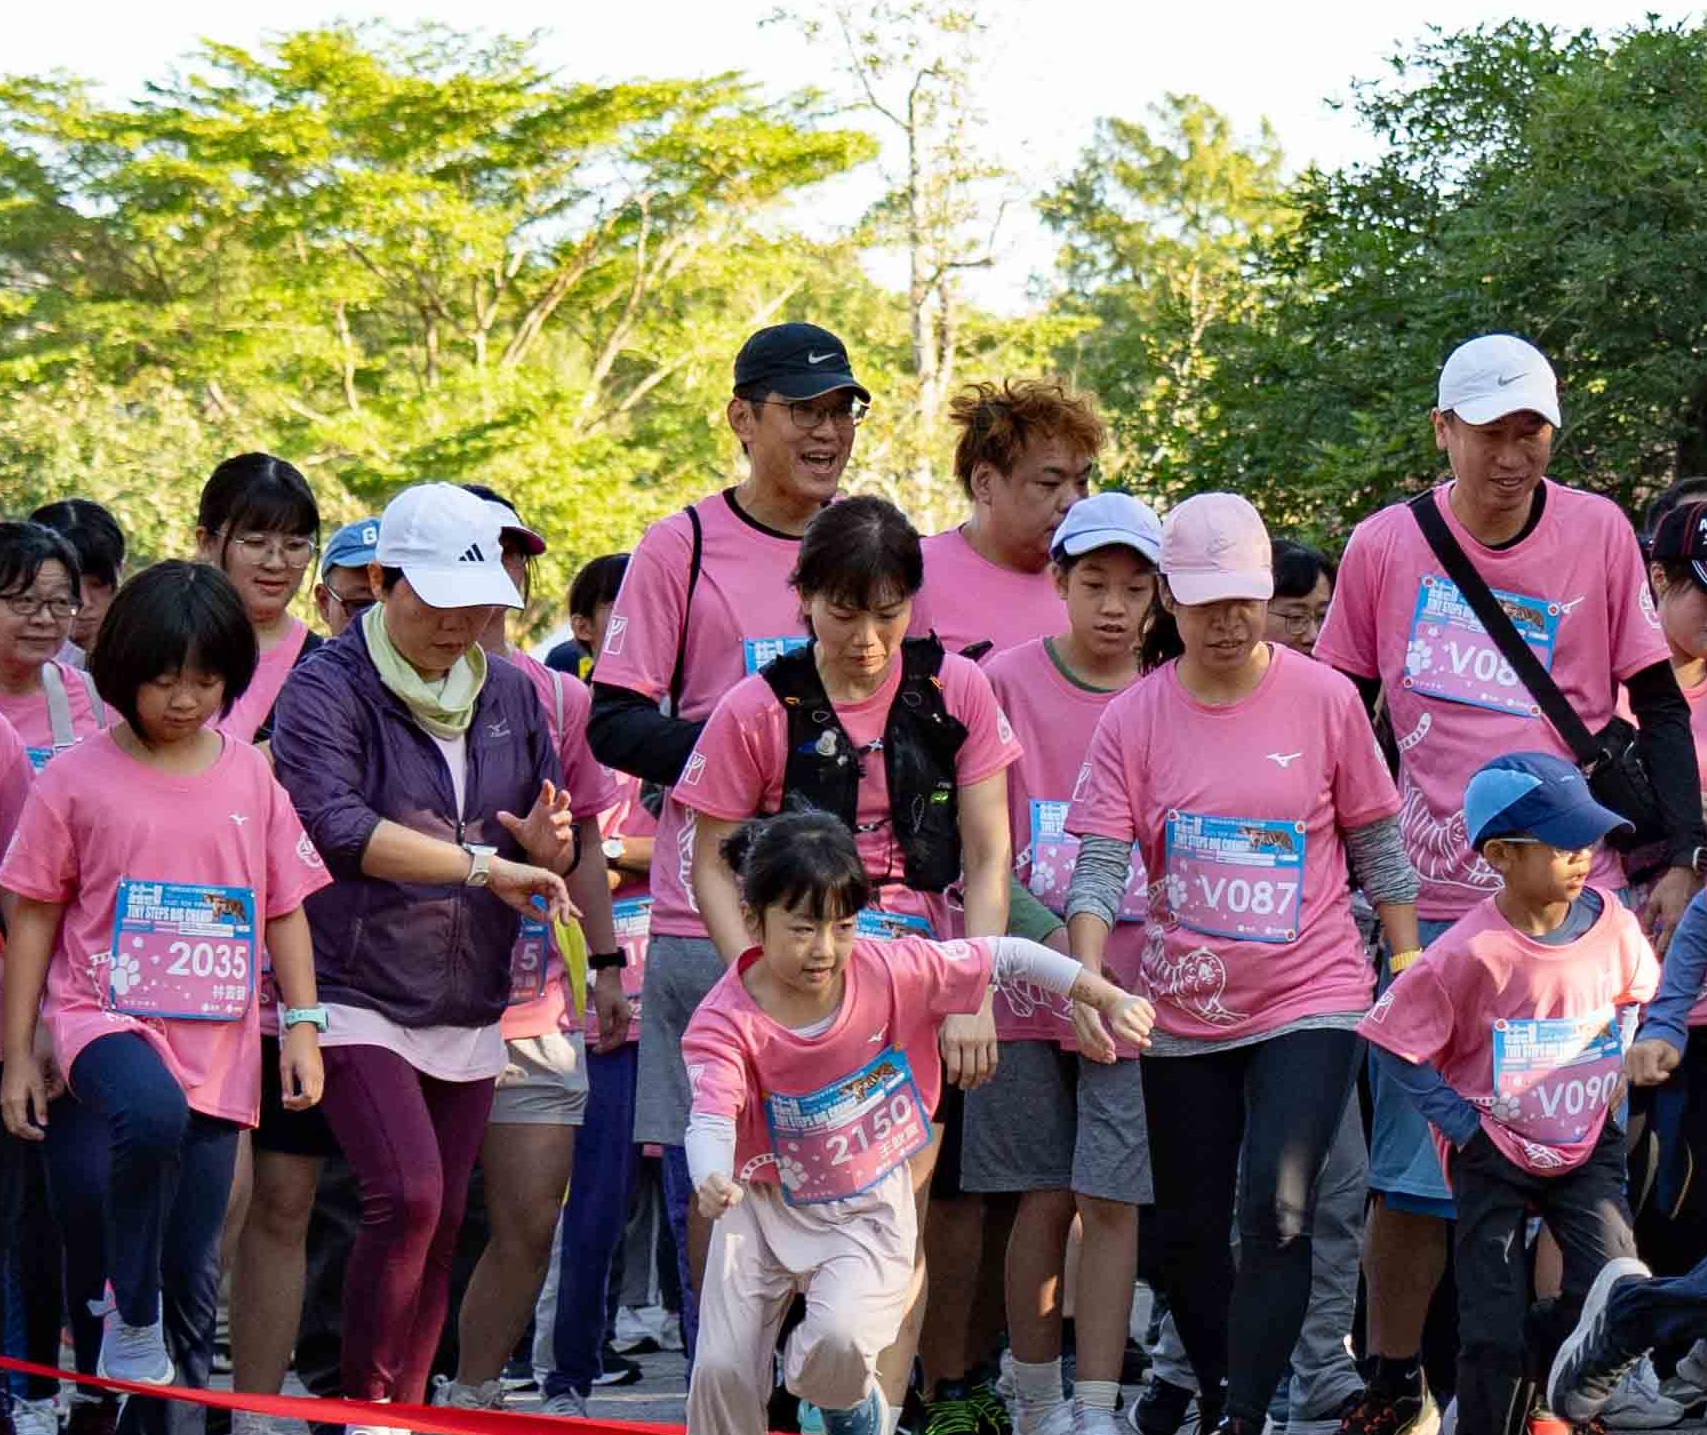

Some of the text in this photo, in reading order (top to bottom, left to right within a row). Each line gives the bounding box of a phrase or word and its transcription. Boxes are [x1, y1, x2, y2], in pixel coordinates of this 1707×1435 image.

[1200, 874, 1298, 915] V087
[165, 941, 247, 980] 2035
[1537, 1070, 1619, 1118] V090
[825, 1093, 912, 1167] 2150
